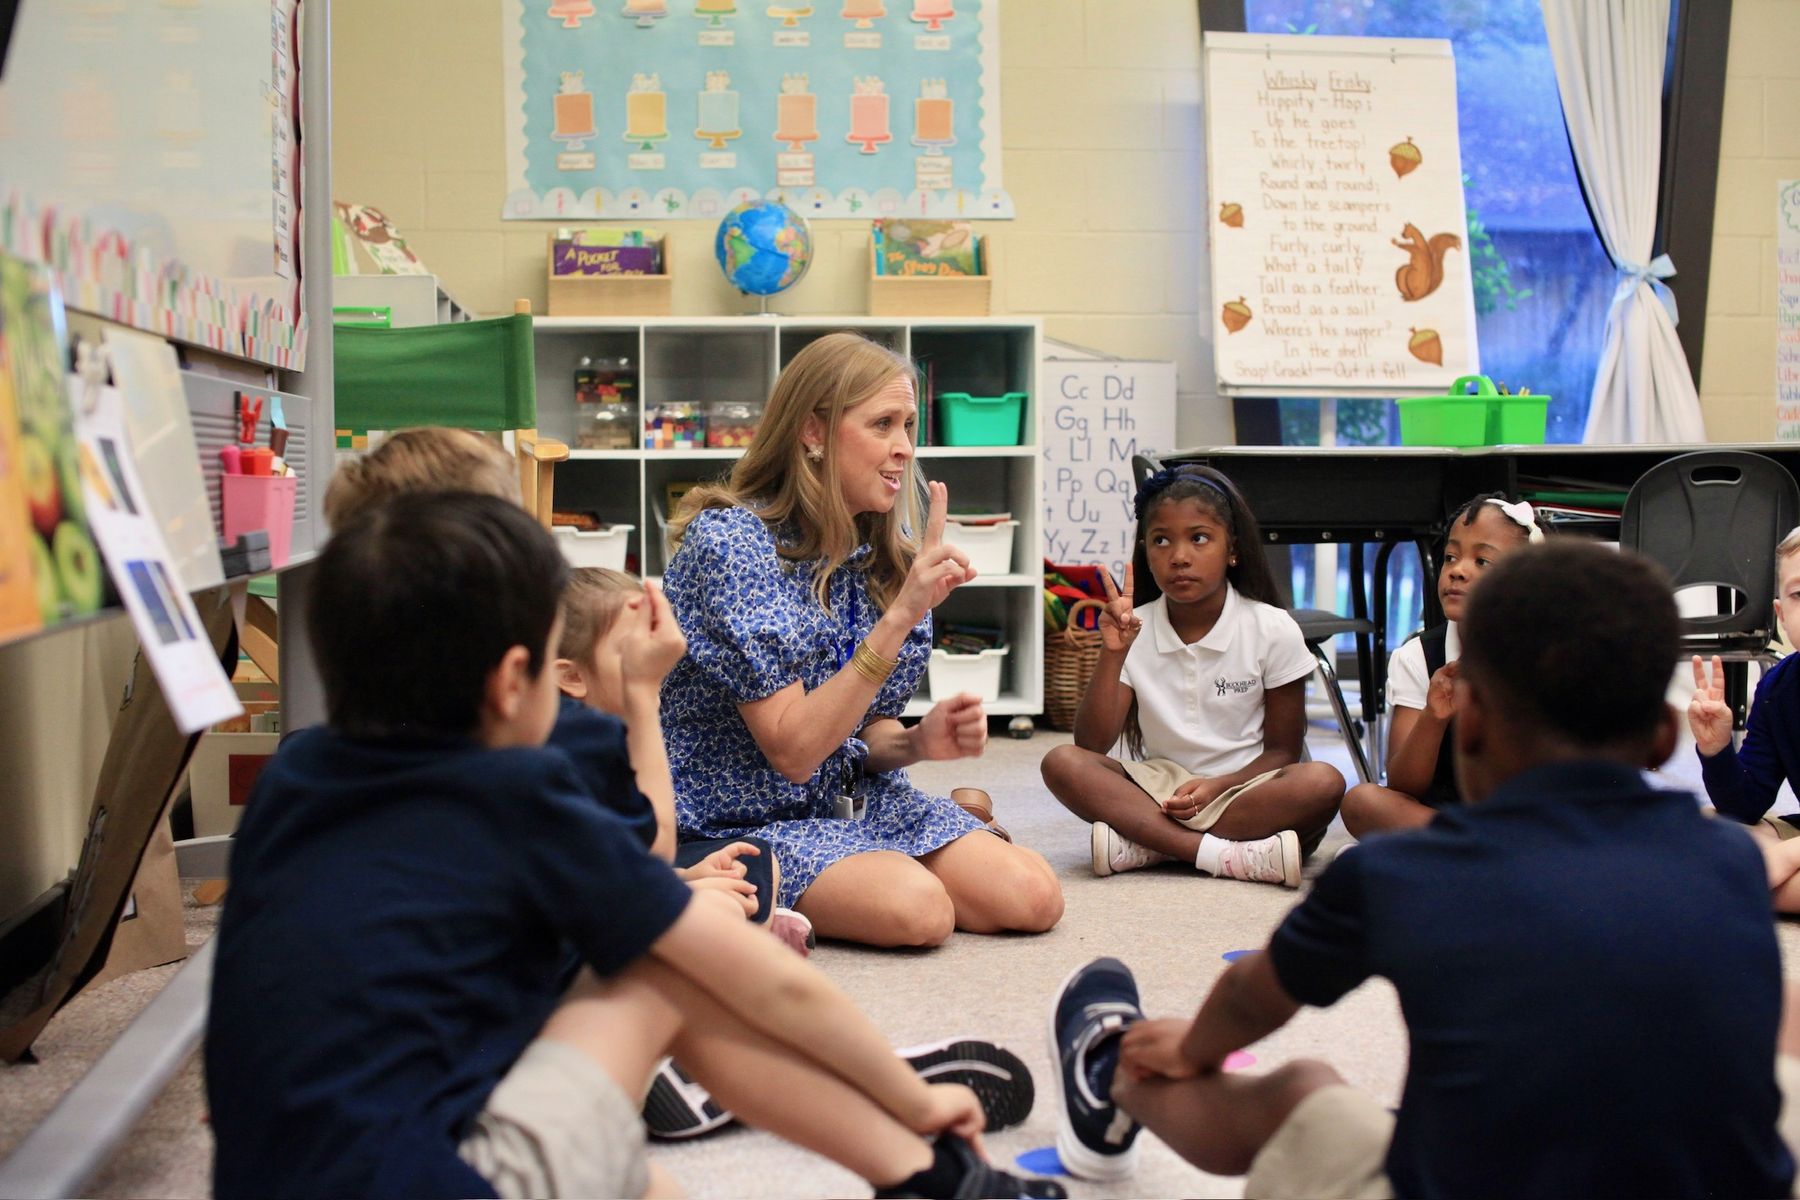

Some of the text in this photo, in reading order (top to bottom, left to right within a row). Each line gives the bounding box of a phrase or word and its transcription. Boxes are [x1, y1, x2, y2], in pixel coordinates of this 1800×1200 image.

[1266, 110, 1356, 134] Up he goes
[1251, 130, 1266, 148] To
[1273, 130, 1297, 148] the
[1260, 171, 1299, 190] Round
[1305, 175, 1327, 190] and
[1262, 192, 1296, 210] Down
[1302, 193, 1320, 209] he
[1283, 214, 1297, 231] to
[1303, 215, 1327, 231] the
[564, 248, 577, 260] A
[1263, 256, 1298, 272] What
[1307, 263, 1317, 273] a
[1259, 275, 1286, 294] Tall
[1292, 283, 1307, 294] as
[1312, 284, 1322, 294] a
[1309, 304, 1324, 315] as
[1330, 305, 1339, 315] a
[1282, 340, 1300, 357] In
[1311, 341, 1330, 357] the
[1334, 360, 1358, 378] Out
[1366, 362, 1375, 379] it
[1060, 375, 1134, 400] Cc Dd
[1055, 405, 1135, 440] Gg Hh
[1057, 467, 1134, 504] Pp Qq
[1067, 499, 1100, 523] Uu
[1081, 529, 1109, 554] Zz
